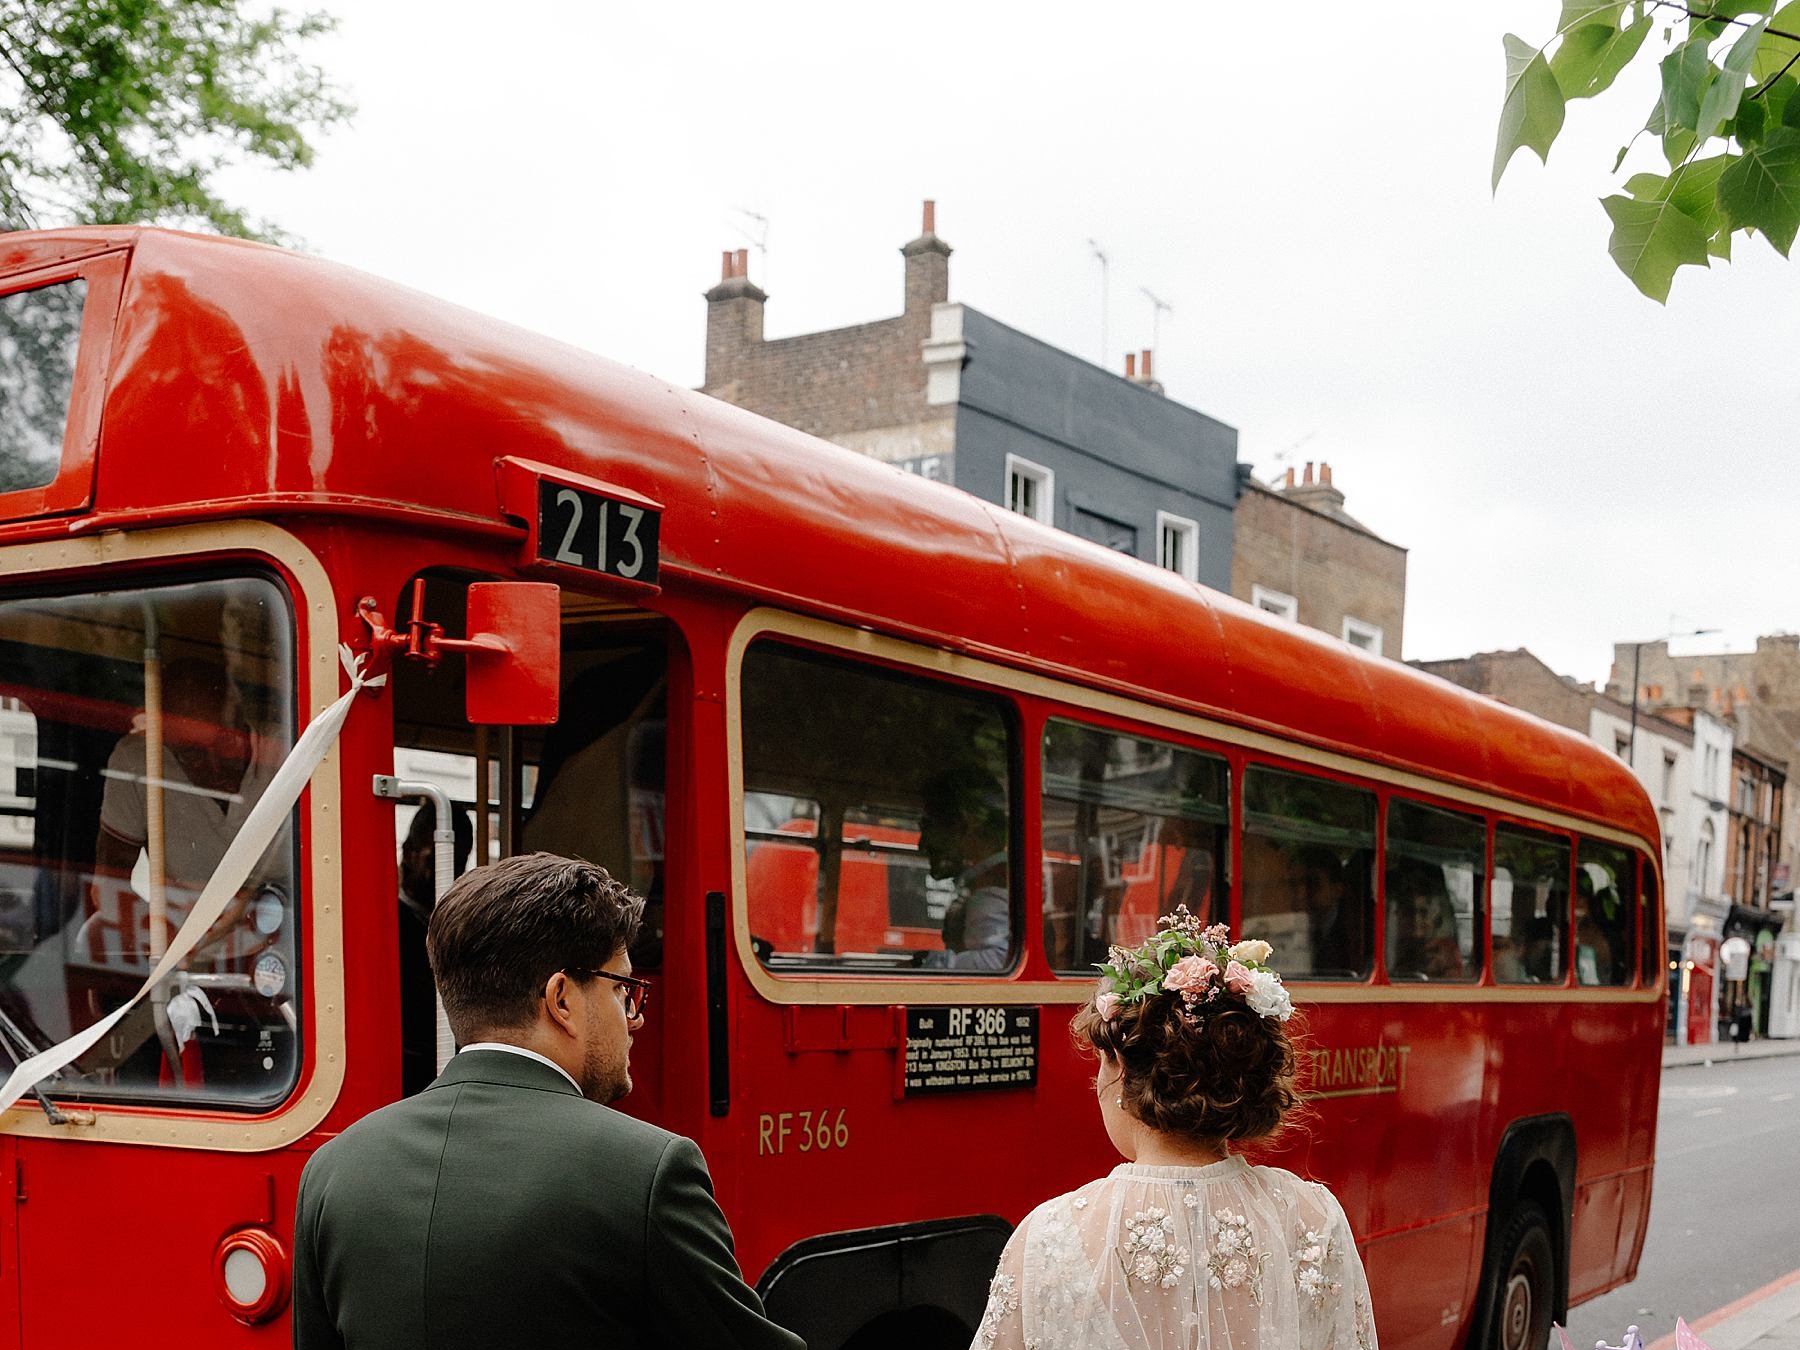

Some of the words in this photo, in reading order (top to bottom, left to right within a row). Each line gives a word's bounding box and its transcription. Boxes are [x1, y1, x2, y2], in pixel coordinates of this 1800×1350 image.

[556, 489, 645, 578] 213
[949, 1008, 973, 1036] RF
[975, 1008, 1006, 1035] 366
[930, 1049, 952, 1061] January
[935, 1059, 967, 1072] KINGSTON
[1310, 1045, 1412, 1090] TRANSPORT
[759, 1112, 793, 1155] RF
[799, 1108, 849, 1152] 366
